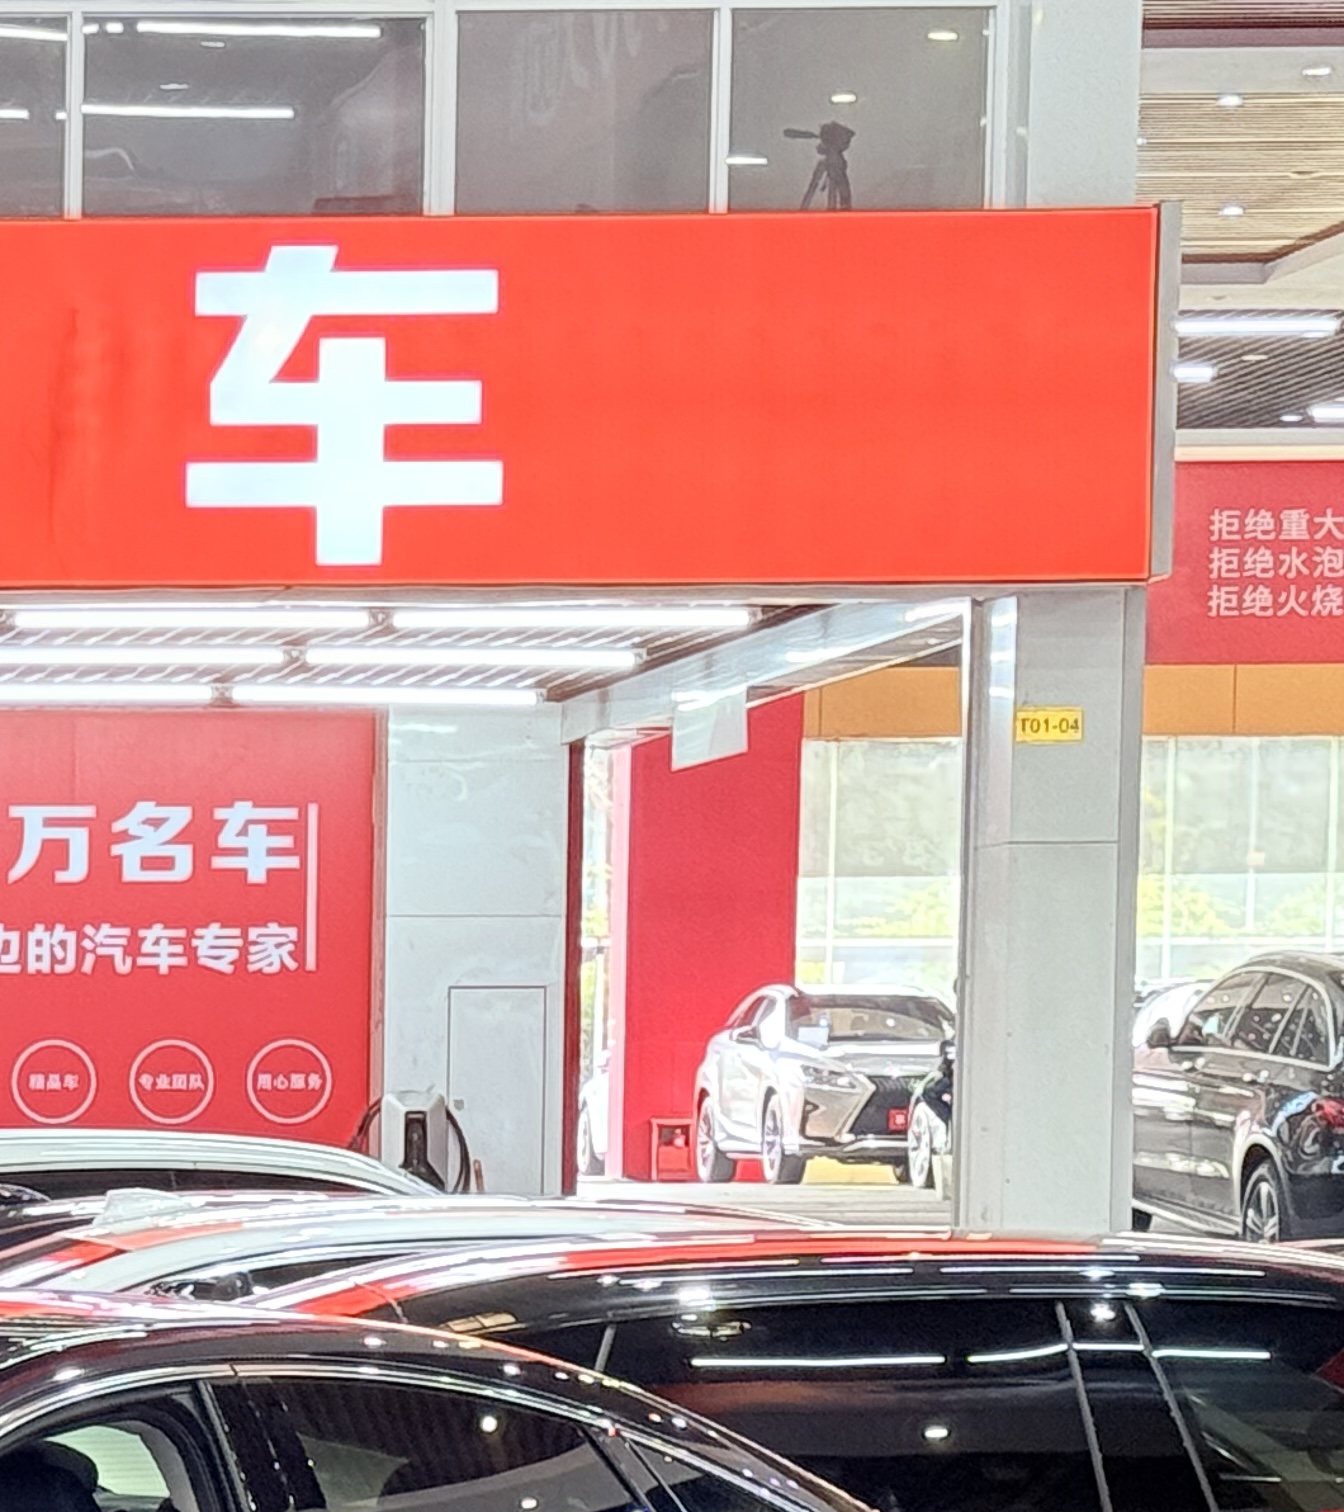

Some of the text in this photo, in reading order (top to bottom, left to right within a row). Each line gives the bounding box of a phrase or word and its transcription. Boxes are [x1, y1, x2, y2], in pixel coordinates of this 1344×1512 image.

[1208, 508, 1344, 541] 拒绝重大
[1208, 546, 1344, 579] 拒绝水泡
[1207, 584, 1344, 617] 拒绝火烧
[1020, 717, 1080, 733] T01-04
